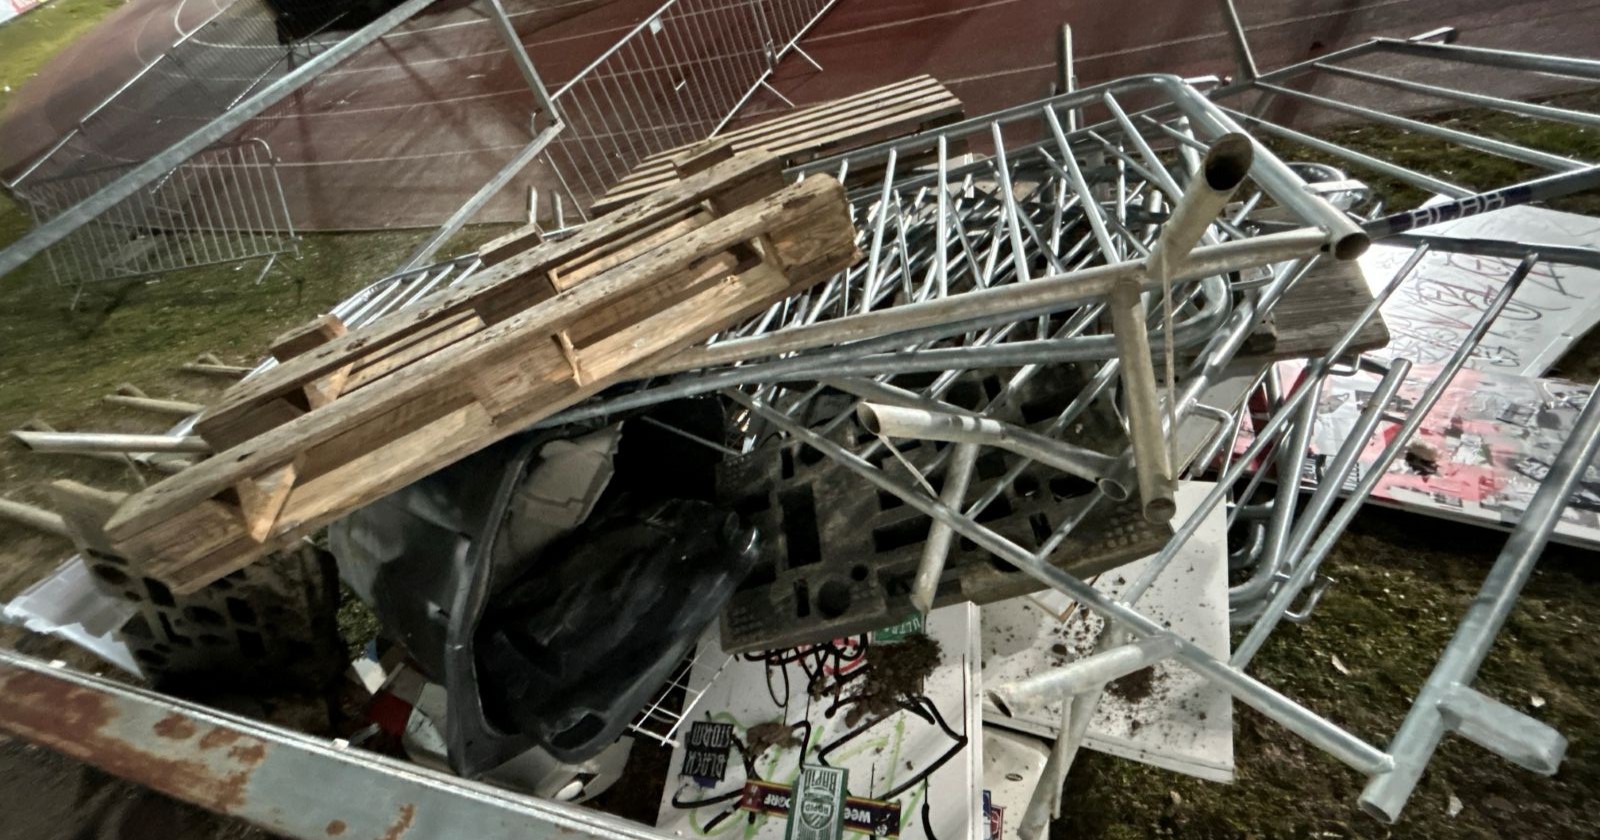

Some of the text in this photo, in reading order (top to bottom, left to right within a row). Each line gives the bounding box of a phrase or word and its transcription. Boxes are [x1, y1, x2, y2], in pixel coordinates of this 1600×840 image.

[884, 617, 921, 635] ULTR
[692, 723, 734, 748] STORM
[685, 750, 727, 778] BLACK
[844, 807, 872, 824] Wee
